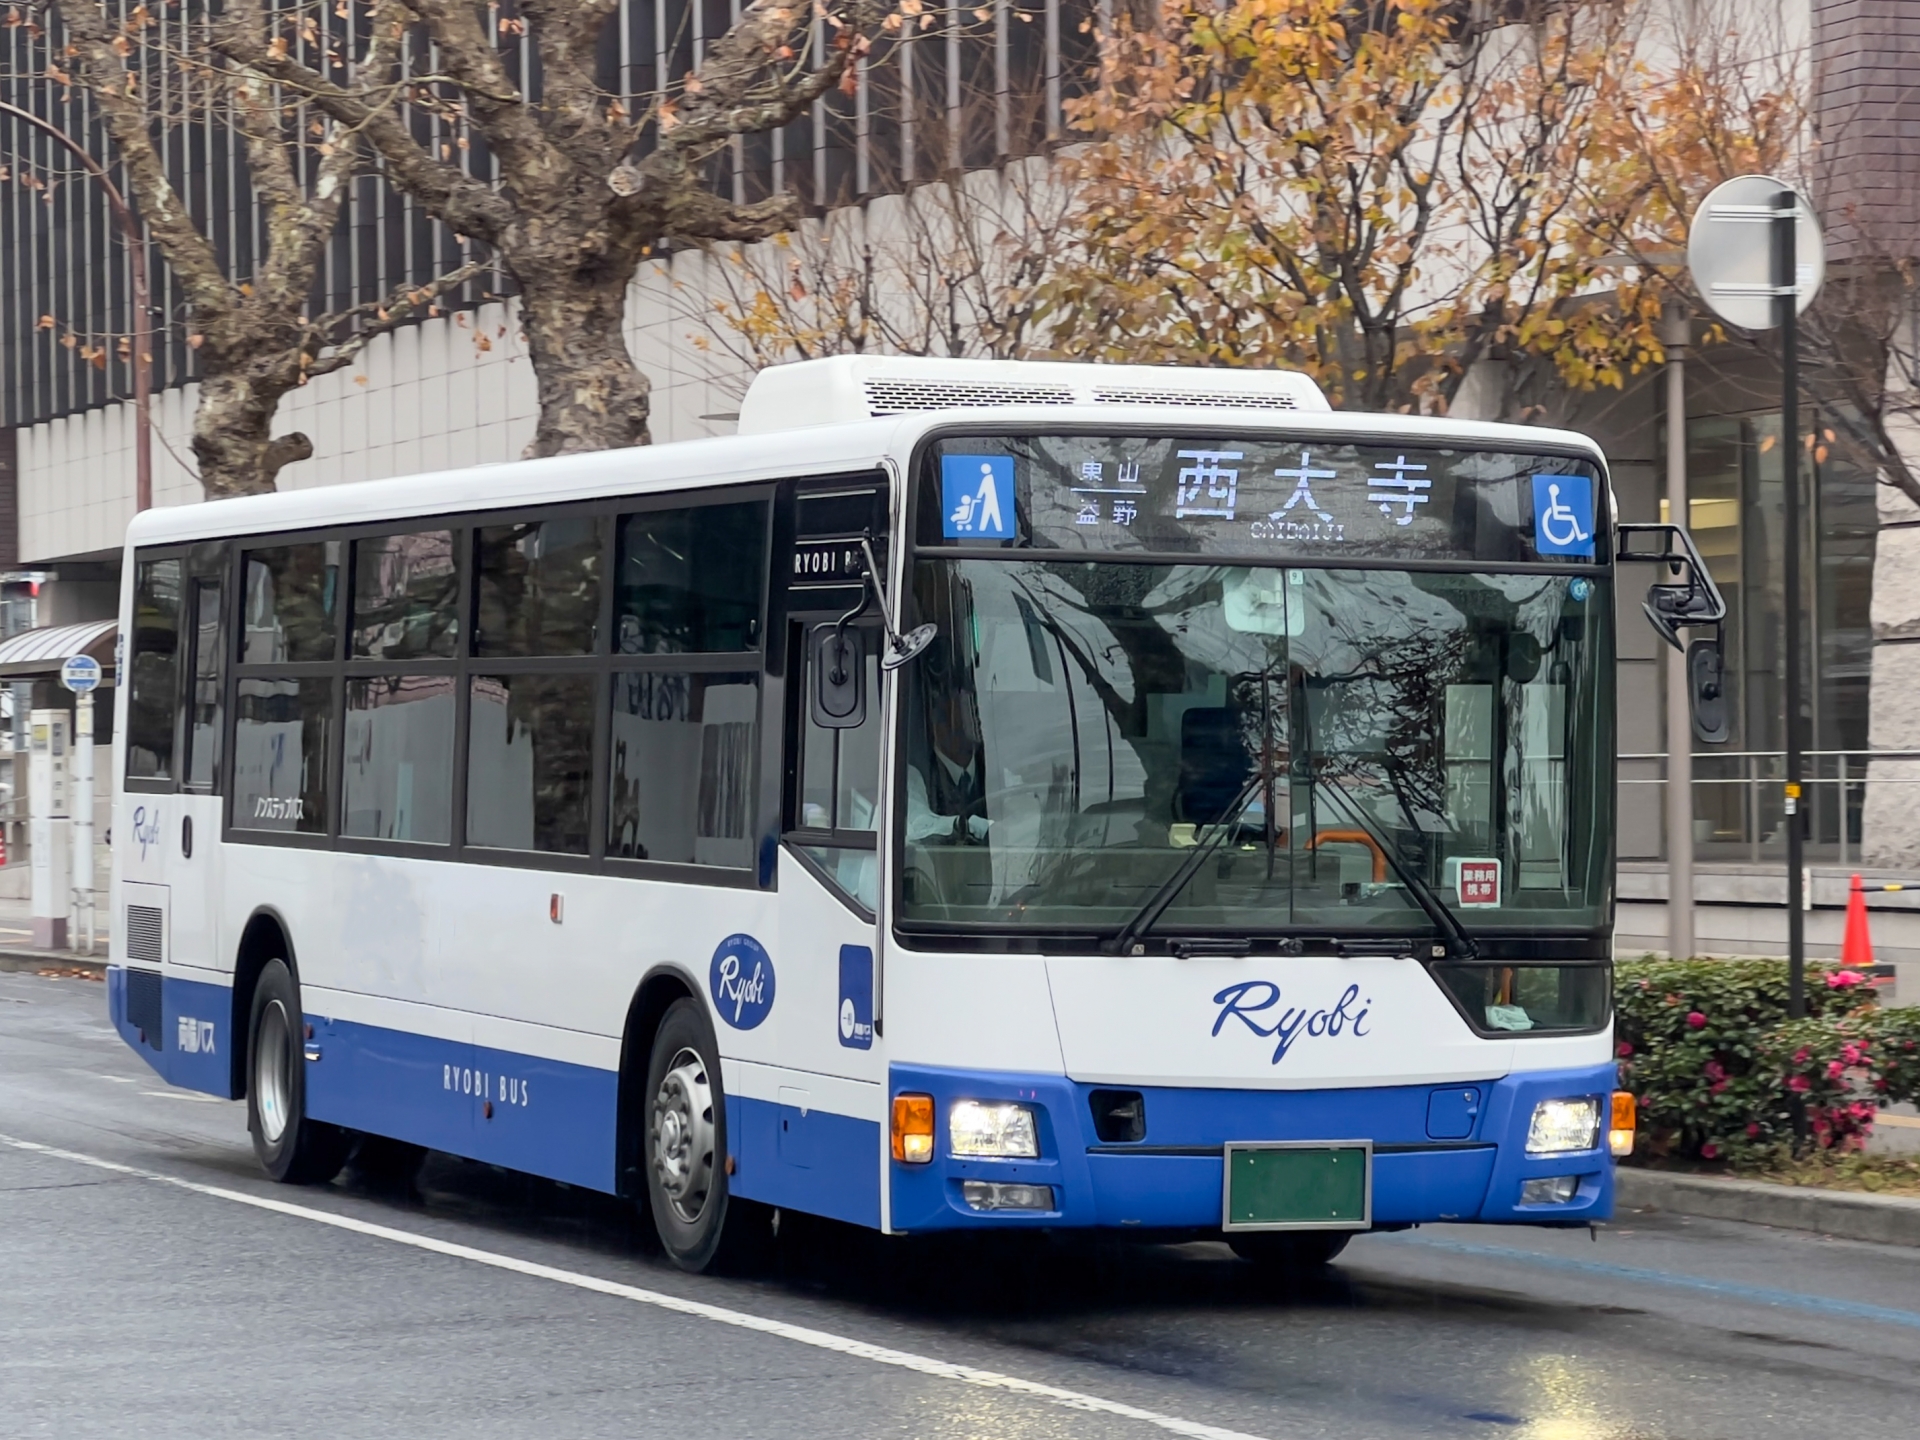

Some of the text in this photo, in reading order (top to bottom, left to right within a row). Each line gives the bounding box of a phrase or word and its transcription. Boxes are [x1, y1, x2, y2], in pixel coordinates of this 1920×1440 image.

[1079, 455, 1140, 483] 東山
[1176, 449, 1432, 526] 西大寺
[1075, 498, 1138, 526] 益野
[794, 551, 836, 574] RYOBI
[718, 954, 765, 1023] Ryobi
[1211, 980, 1372, 1065] Ryobi
[443, 1064, 528, 1107] RYOBI BUS
